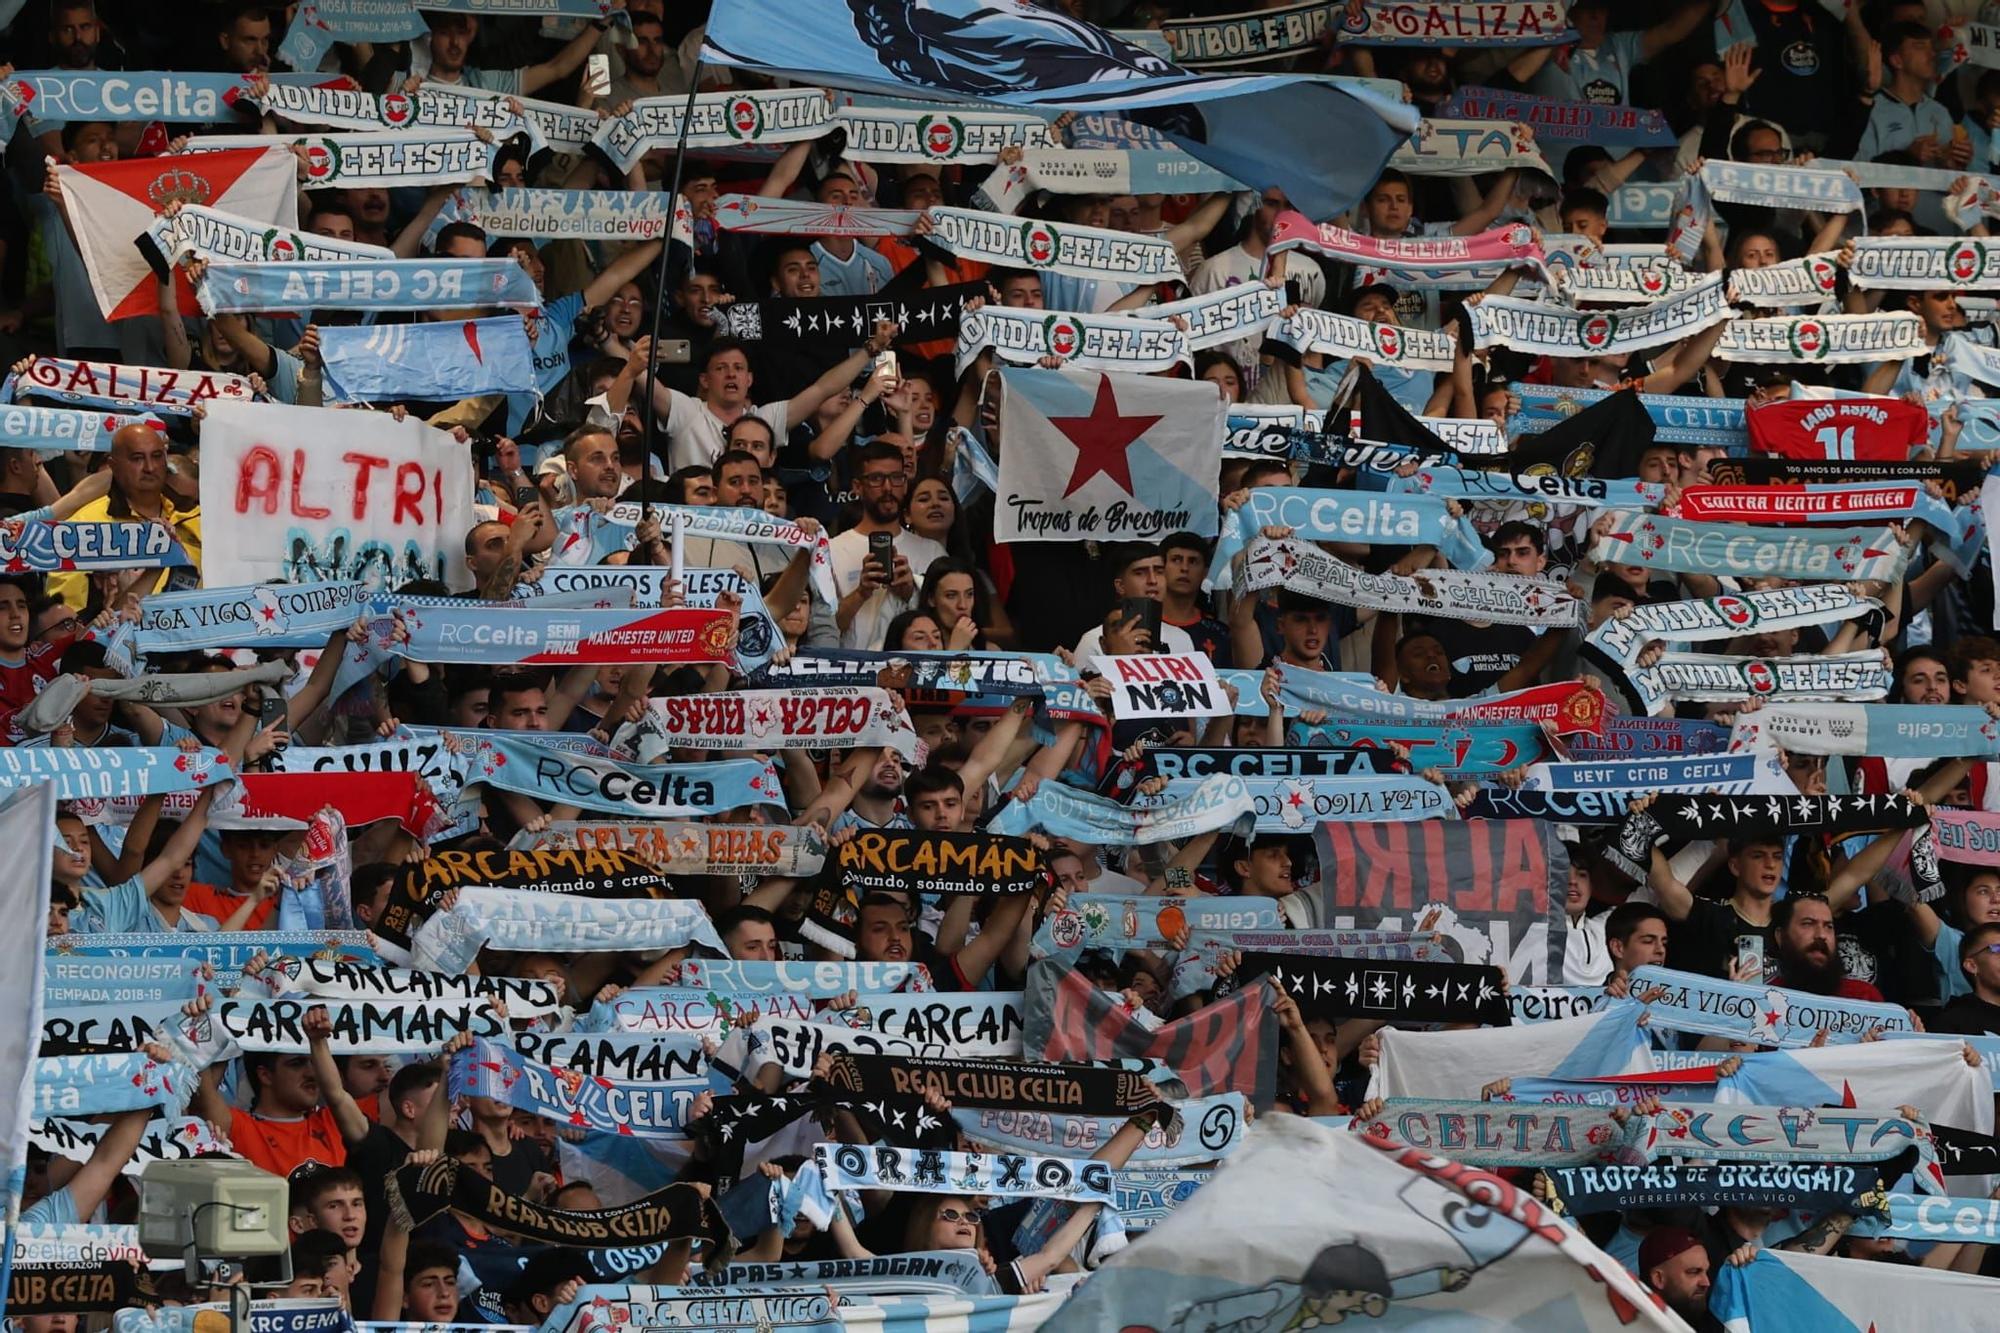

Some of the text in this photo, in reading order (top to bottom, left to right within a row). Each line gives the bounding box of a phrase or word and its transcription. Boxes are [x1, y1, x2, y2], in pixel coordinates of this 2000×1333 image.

[1392, 4, 1543, 36] GALIZA
[38, 77, 217, 117] RCCelta
[1408, 128, 1512, 160] LTA
[341, 143, 488, 178] CELESTE
[1614, 186, 1675, 221] Cel
[158, 211, 266, 263] MOVIDA
[936, 214, 1180, 274] OVIDA CELESTE
[1186, 288, 1282, 341] LESTE
[1476, 304, 1580, 346] MOVIDA
[532, 351, 567, 372] ROËN
[29, 357, 220, 403] GALIZA
[3, 408, 77, 438] elta
[1800, 402, 1889, 432] IAGO ASPAS
[234, 445, 444, 527] ALTRI
[1786, 465, 1941, 476] 100 ANOS DE AFOUTEZA E CORAZÓN
[1007, 493, 1192, 537] Tropas de Breogán
[1250, 491, 1420, 538] RCCelta
[1702, 491, 1905, 511] CONTRA E MAREA
[52, 522, 172, 558] CELTA
[1668, 524, 1829, 573] RCCelta
[553, 573, 651, 595] CORVOS
[1299, 556, 1524, 608] REAL CLUB CELTA
[191, 600, 251, 627] VIGO
[1417, 598, 1444, 610] VIGO
[439, 622, 538, 646] RCCelta
[546, 624, 581, 639] SEMI
[587, 628, 695, 646] MANCHESTER UNITED
[1600, 598, 1722, 657] MOVIDA
[542, 640, 581, 655] FINAL
[970, 657, 1036, 683] VIG
[1113, 656, 1204, 683] ALTRI
[1636, 662, 1750, 701] MOVIDA
[780, 698, 872, 736] CELTA
[1454, 702, 1558, 720] MANCHESTER UNITED
[1897, 722, 1969, 739] RCCelta
[0, 748, 123, 775] CORAZÓ
[1153, 751, 1377, 777] RC CELTA
[537, 756, 715, 807] RCCelta
[1314, 790, 1442, 816] ELTA VIGO
[1937, 818, 1964, 848] Eu
[839, 832, 1046, 880] ARCAMÄN
[519, 875, 614, 894] soñando e
[916, 873, 1001, 893] soñando e
[56, 964, 182, 980] RECONQUISTA
[703, 961, 909, 991] RCCelta
[47, 987, 162, 1001] TEMPADA 2018-19
[1698, 988, 1756, 1019] VIGO
[515, 1031, 703, 1081] RCAMÄN
[891, 1065, 1083, 1105] REAL CLUB CELTA
[1115, 1073, 1126, 1092] CELTA
[606, 1089, 692, 1128] CELT
[980, 1111, 1099, 1149] FORA DE
[1398, 1112, 1576, 1153] CELTA
[1689, 1111, 1915, 1153] CELTA
[1145, 1172, 1180, 1181] NUNCA
[1557, 1165, 1677, 1196] TROPAS
[1687, 1167, 1706, 1182] DE
[486, 1184, 549, 1229] REAL
[551, 1215, 609, 1239] CLUB
[610, 1206, 672, 1239] CELTA
[1619, 1191, 1796, 1206] GUERREIRXS CELTA VIGO
[50, 1273, 115, 1303] CELTA
[693, 1263, 783, 1288] ROPAS
[630, 1296, 831, 1328] R.C. CELTA VIGO
